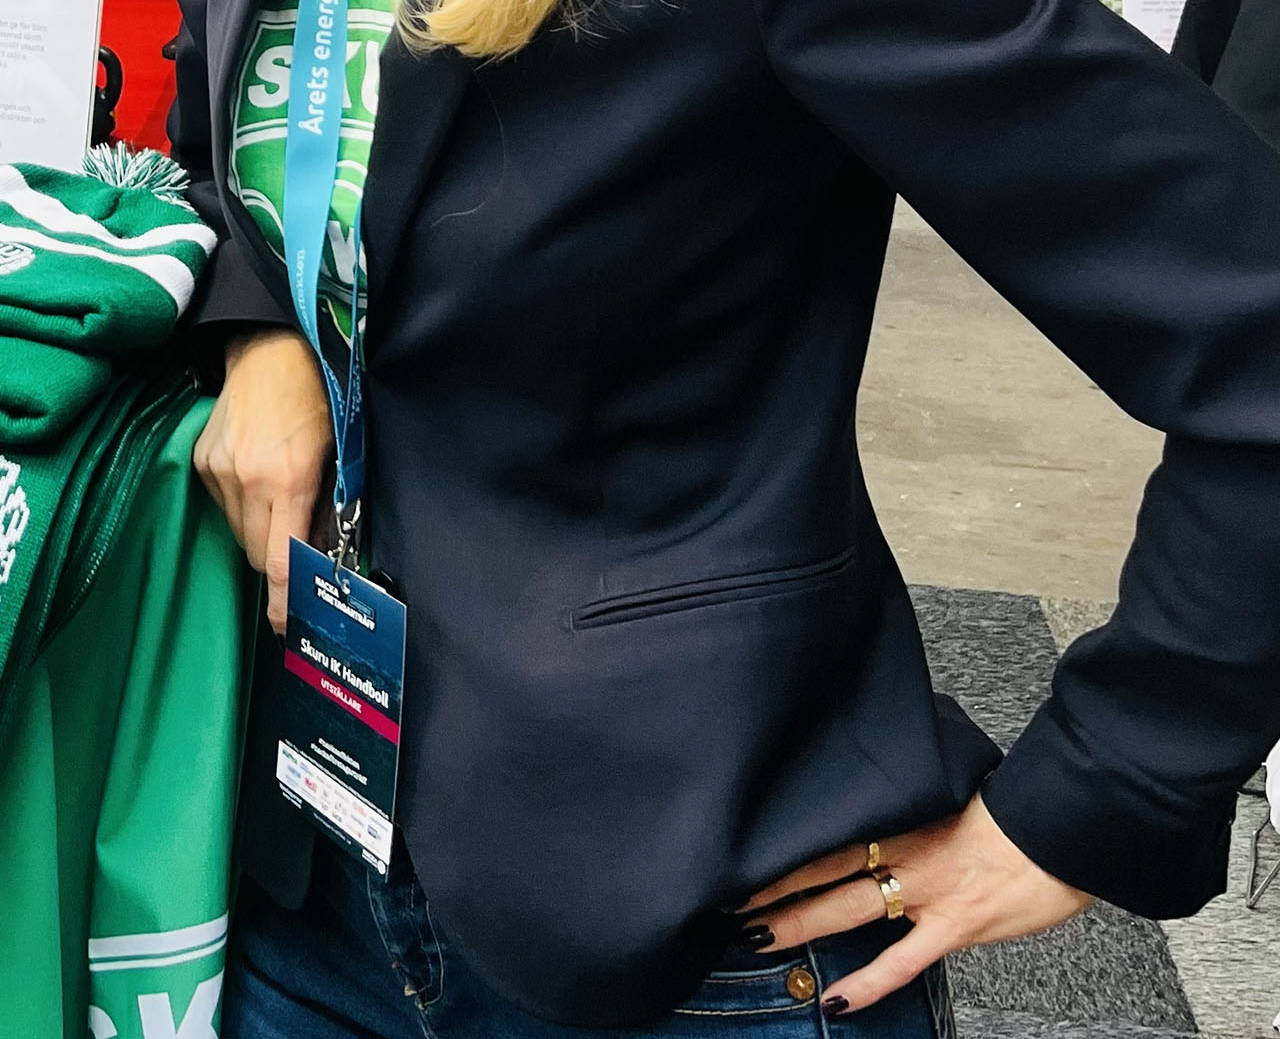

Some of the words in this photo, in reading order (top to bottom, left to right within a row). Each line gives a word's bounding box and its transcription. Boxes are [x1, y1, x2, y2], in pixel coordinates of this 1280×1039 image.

[298, 67, 328, 136] Årets
[299, 637, 330, 668] Skuru
[330, 657, 344, 677] IK
[342, 666, 390, 709] Handboll
